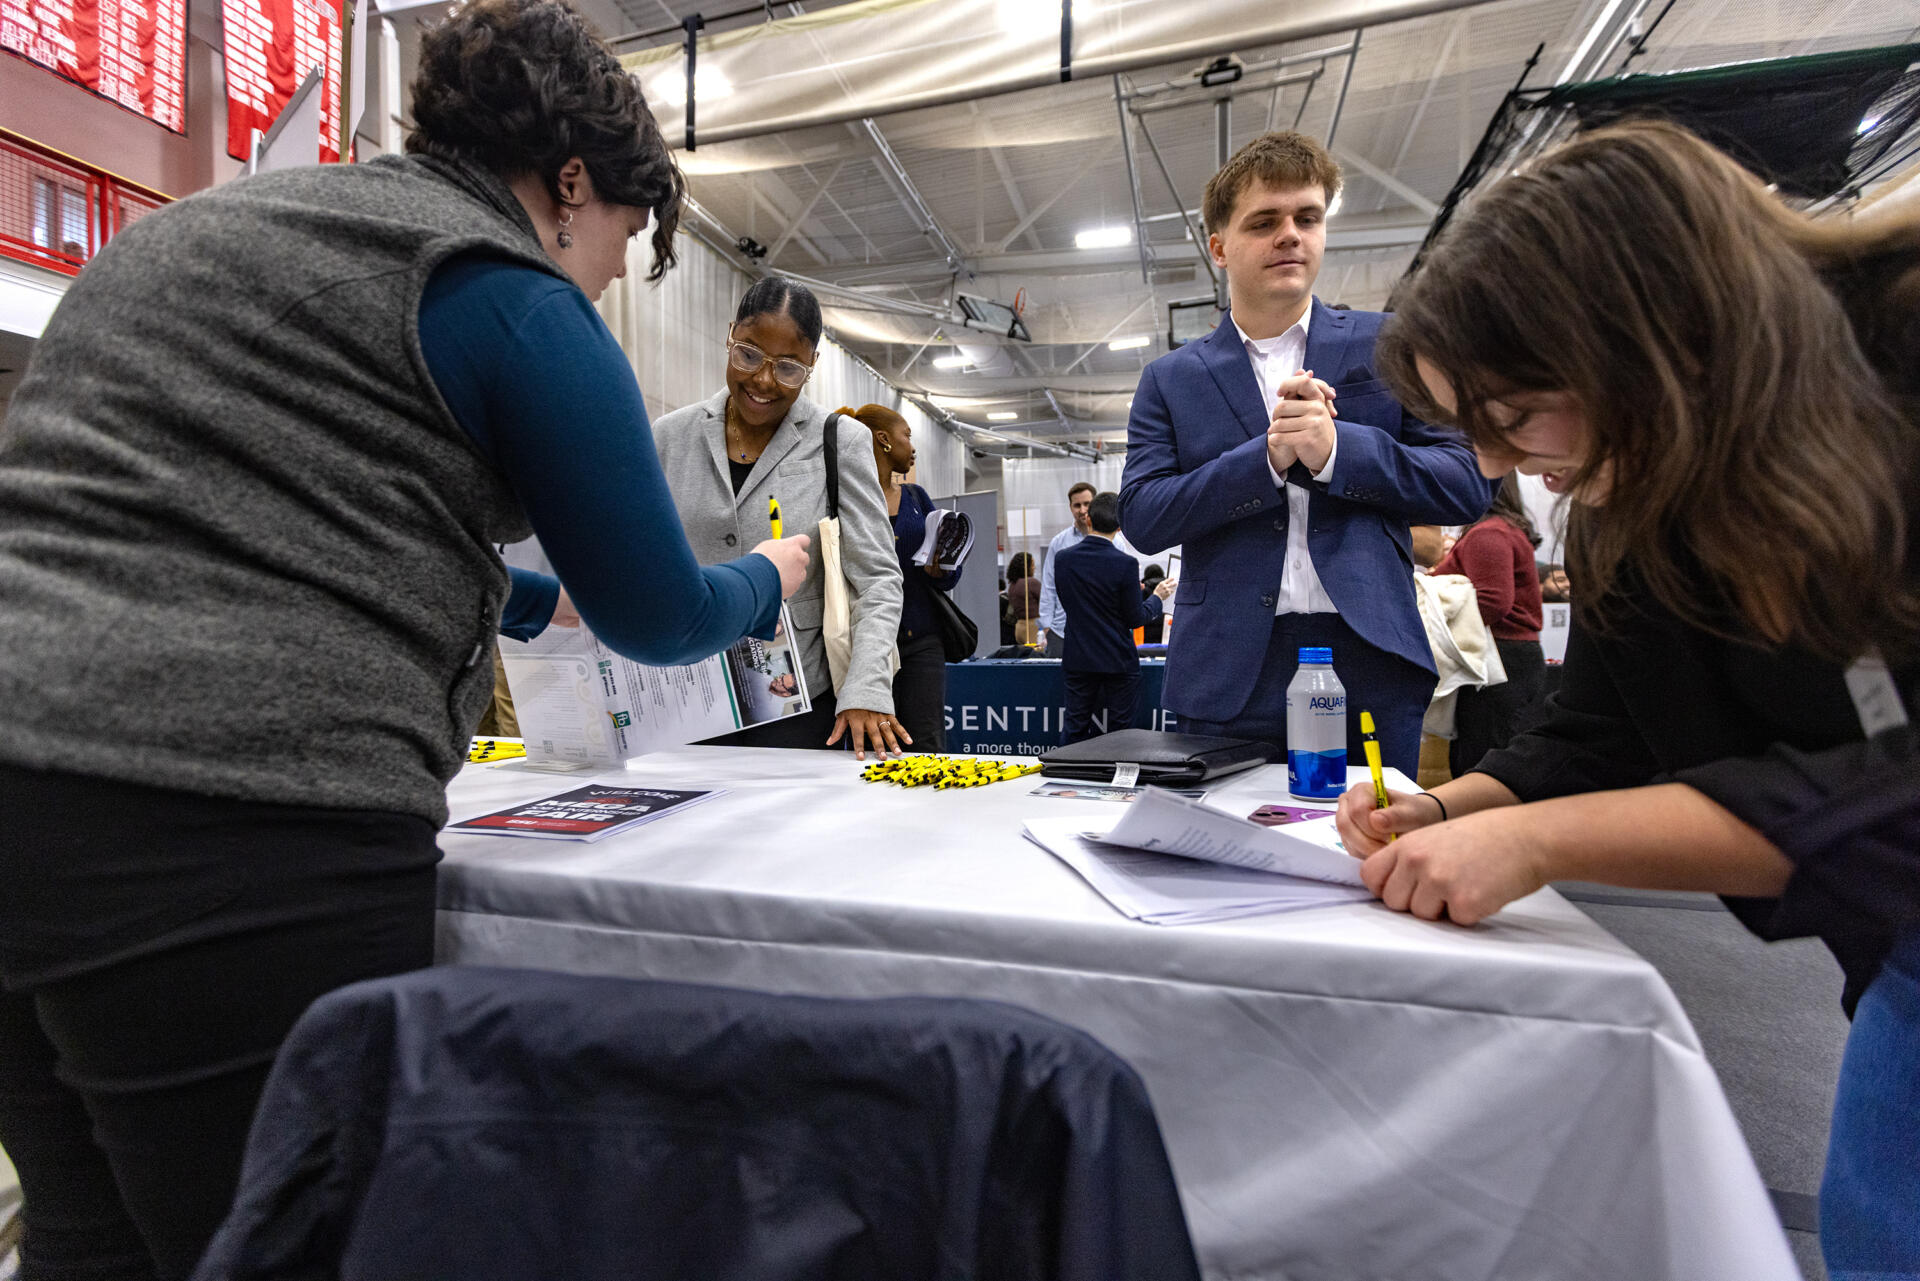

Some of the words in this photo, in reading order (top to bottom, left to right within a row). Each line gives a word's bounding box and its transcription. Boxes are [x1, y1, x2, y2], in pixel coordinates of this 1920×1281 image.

[963, 743, 971, 753] a
[976, 743, 1012, 754] more
[535, 799, 651, 813] MEGA
[512, 809, 615, 822] FAIR
